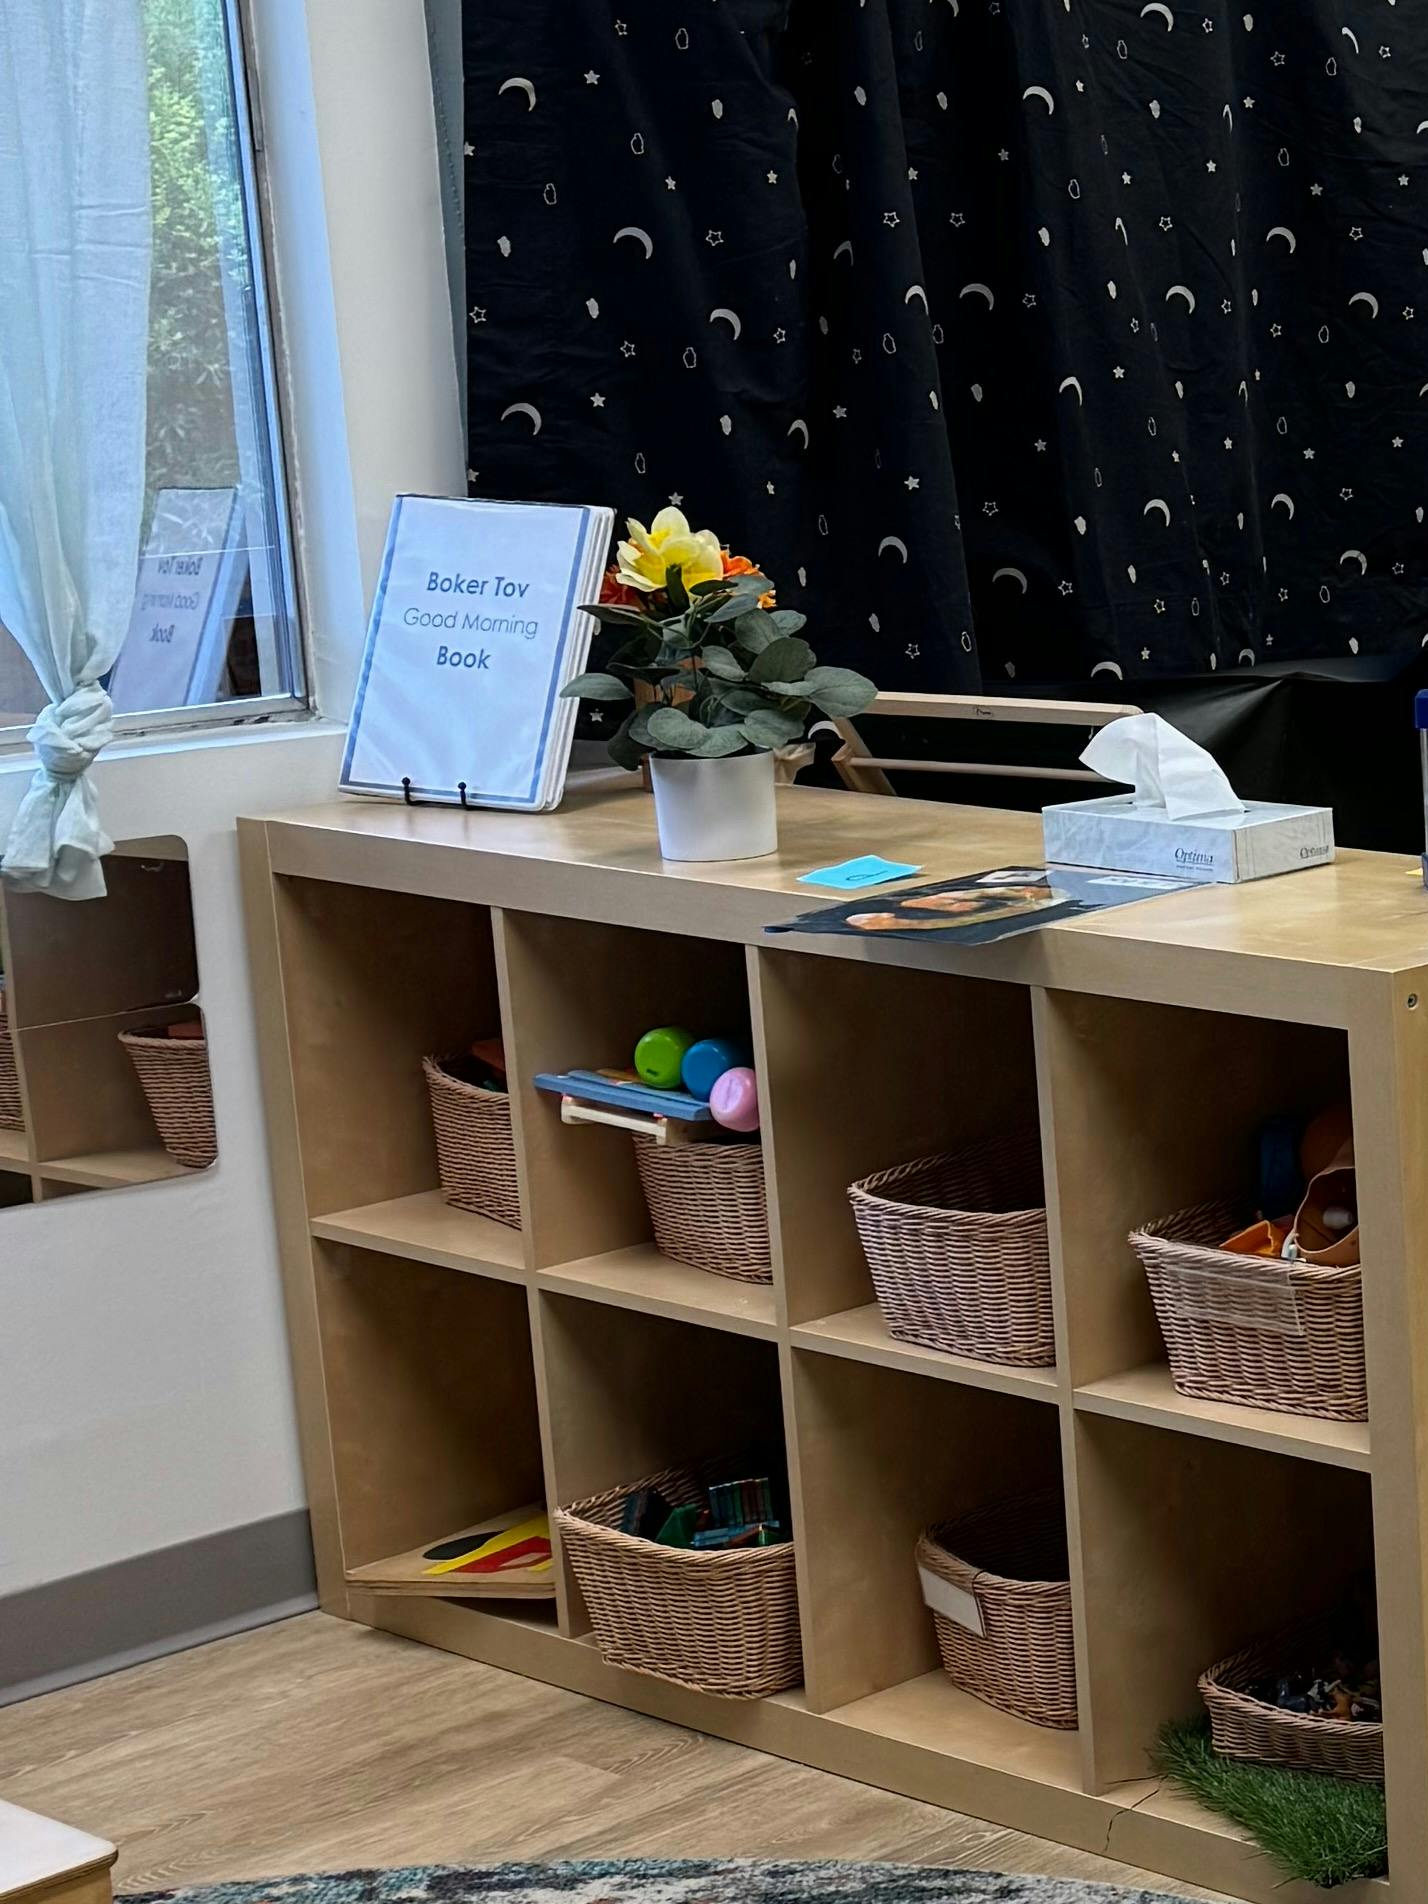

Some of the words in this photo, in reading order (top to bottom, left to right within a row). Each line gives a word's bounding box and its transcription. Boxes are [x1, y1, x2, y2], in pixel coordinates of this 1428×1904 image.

[427, 571, 488, 595] Boker
[495, 576, 530, 597] Tov
[403, 607, 457, 629] Good
[461, 612, 538, 640] Morning
[436, 646, 491, 669] Book
